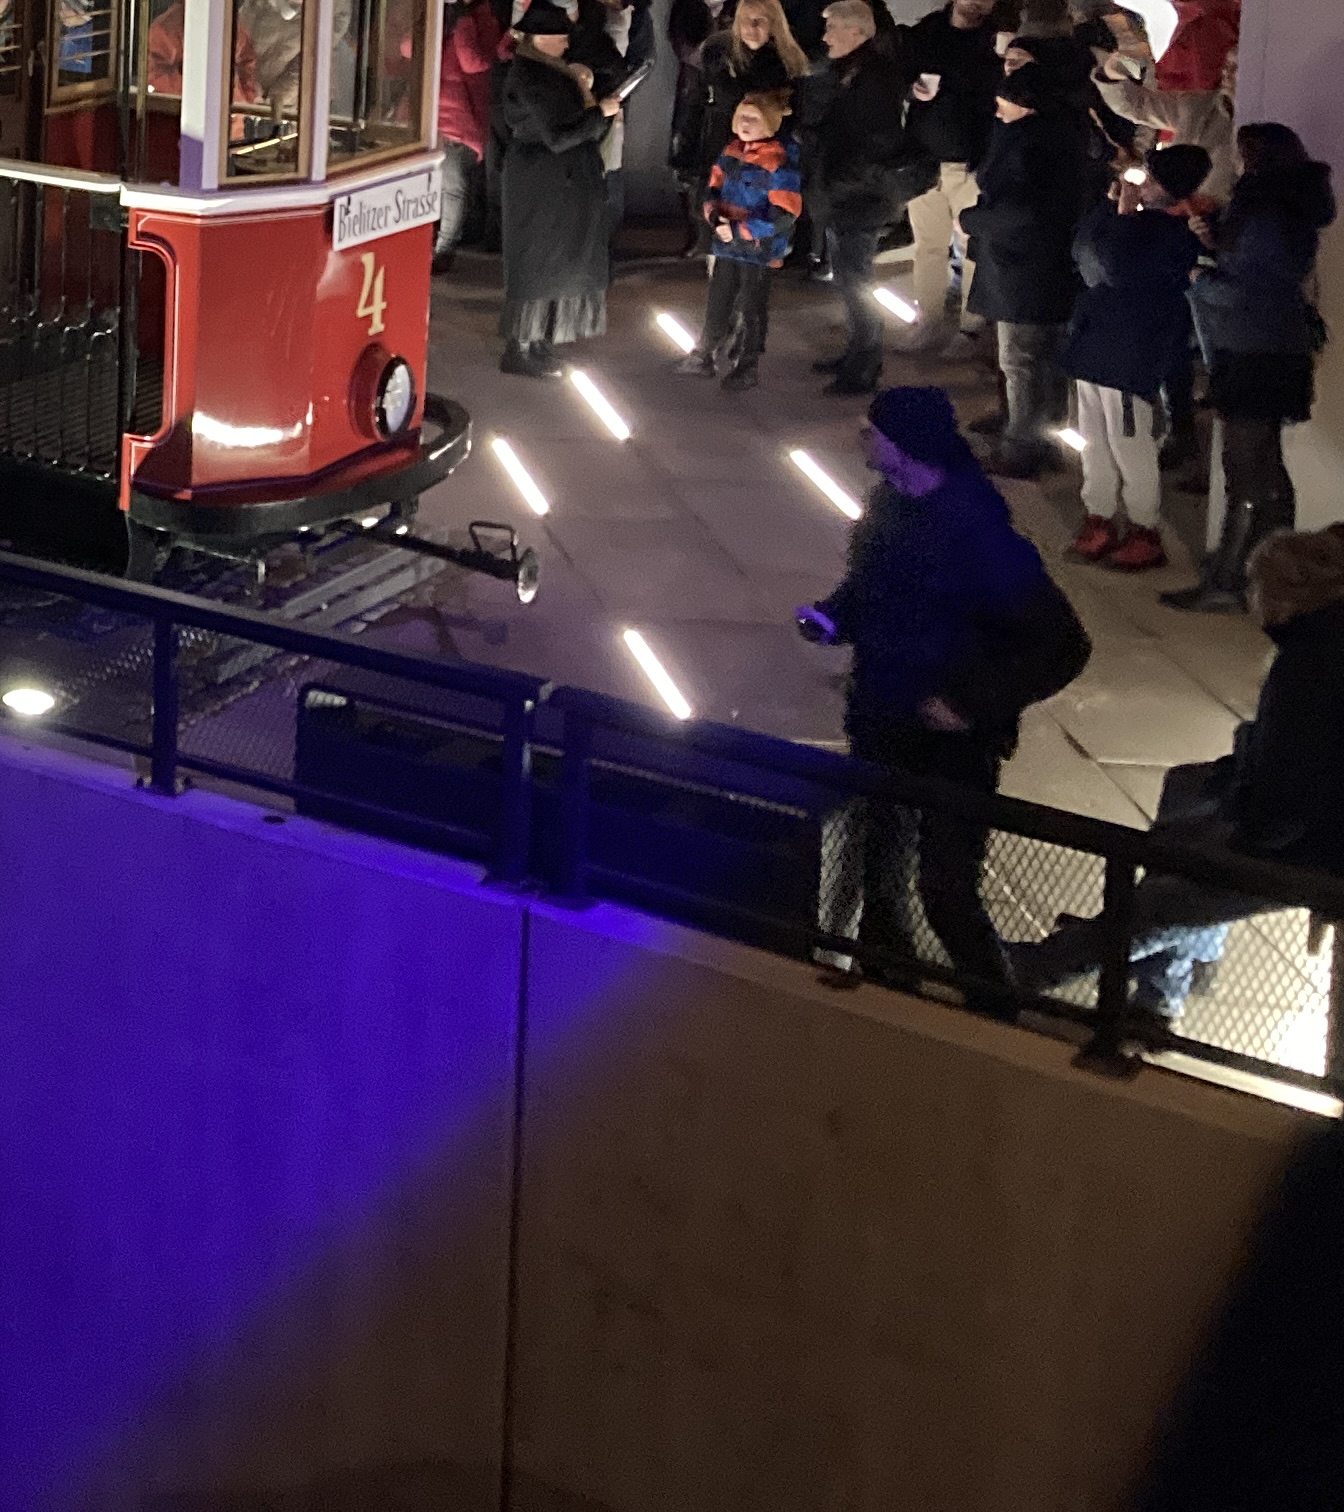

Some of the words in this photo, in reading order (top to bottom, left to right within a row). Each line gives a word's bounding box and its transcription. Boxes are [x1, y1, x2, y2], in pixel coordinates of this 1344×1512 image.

[338, 201, 391, 242] Bielitzer
[394, 189, 438, 224] Strasse
[356, 252, 387, 336] 4
